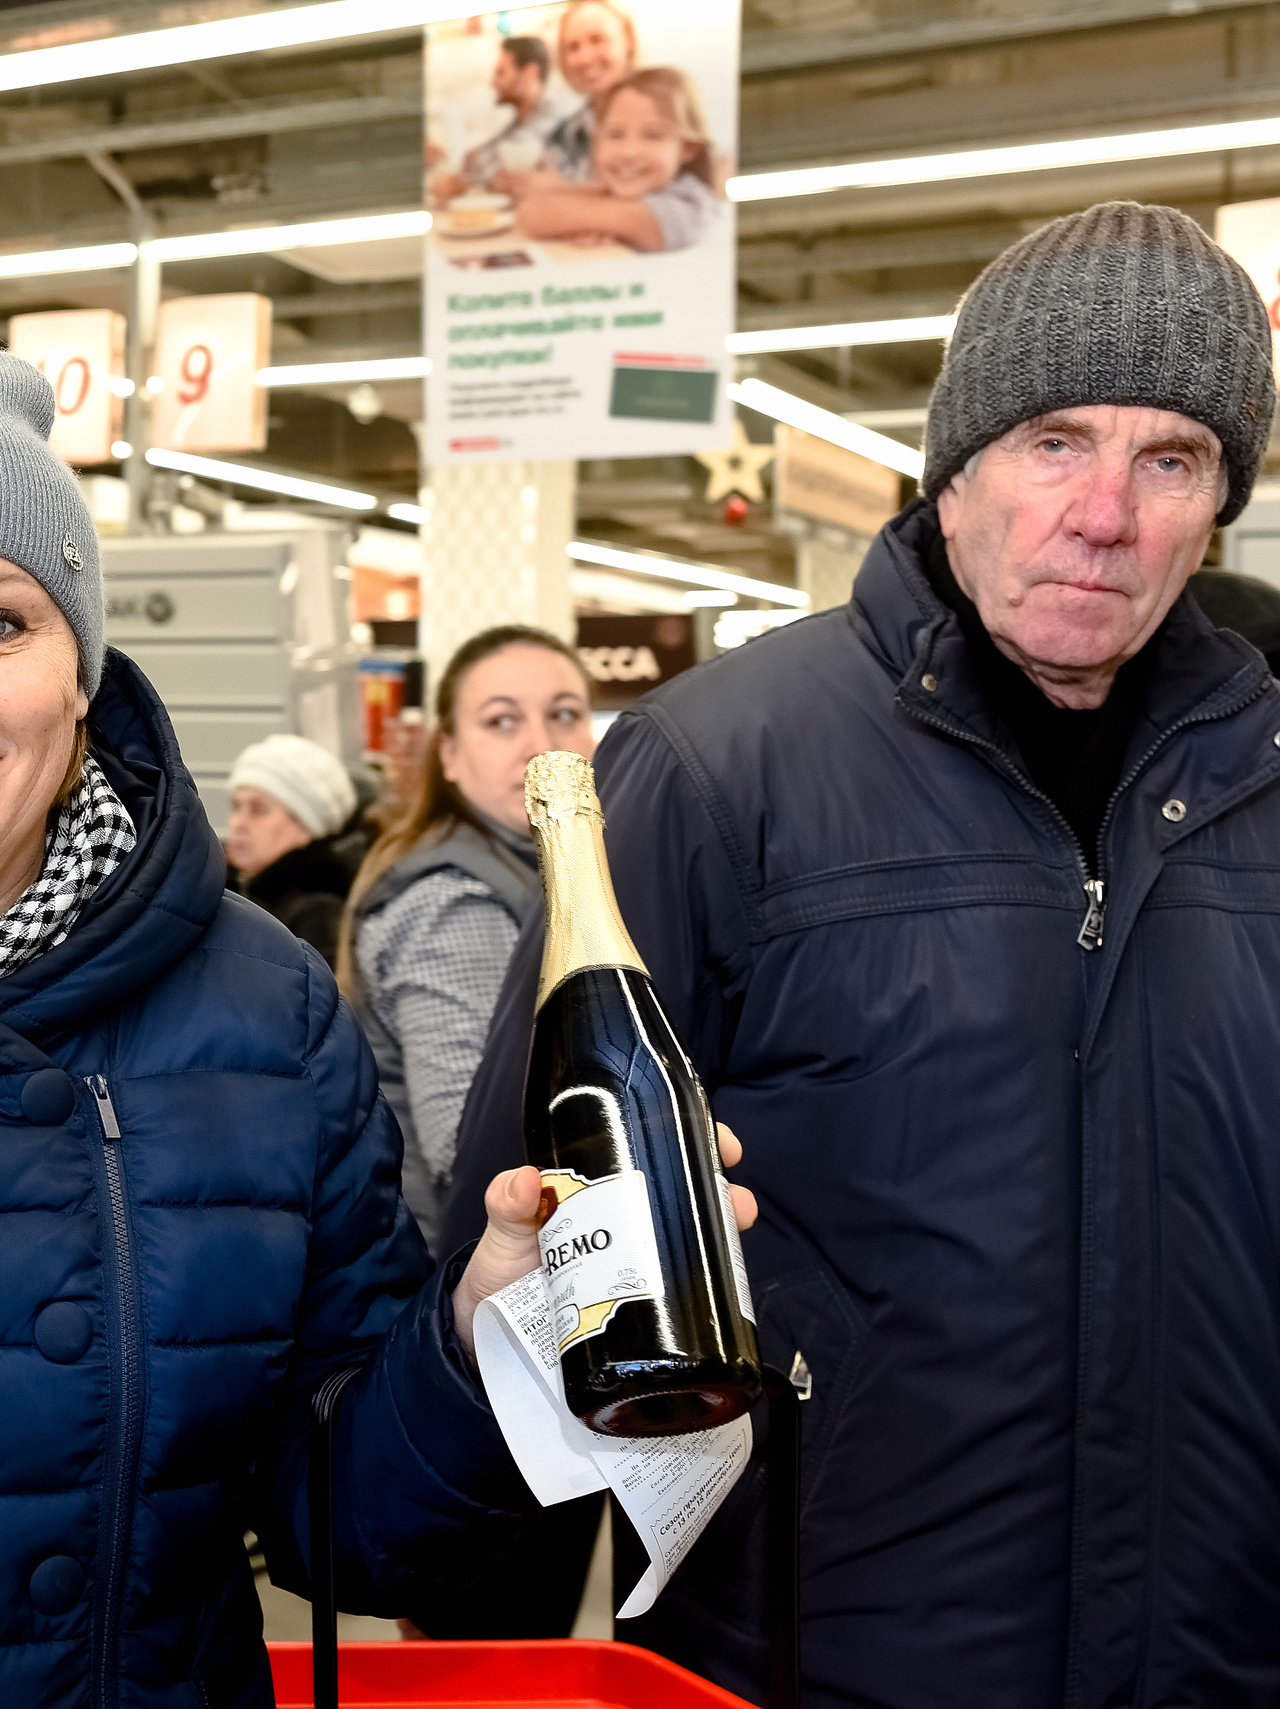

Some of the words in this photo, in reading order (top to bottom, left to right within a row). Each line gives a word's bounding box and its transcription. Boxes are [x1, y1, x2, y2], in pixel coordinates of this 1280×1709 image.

[38, 357, 90, 416] 0
[177, 344, 213, 406] 9
[542, 1229, 613, 1276] REMO
[524, 1315, 546, 1335] ИТОГ
[660, 1511, 682, 1535] Сезон
[683, 1459, 728, 1512] праздничных
[678, 1517, 686, 1528] 13
[687, 1507, 696, 1519] по
[697, 1494, 704, 1506] 15
